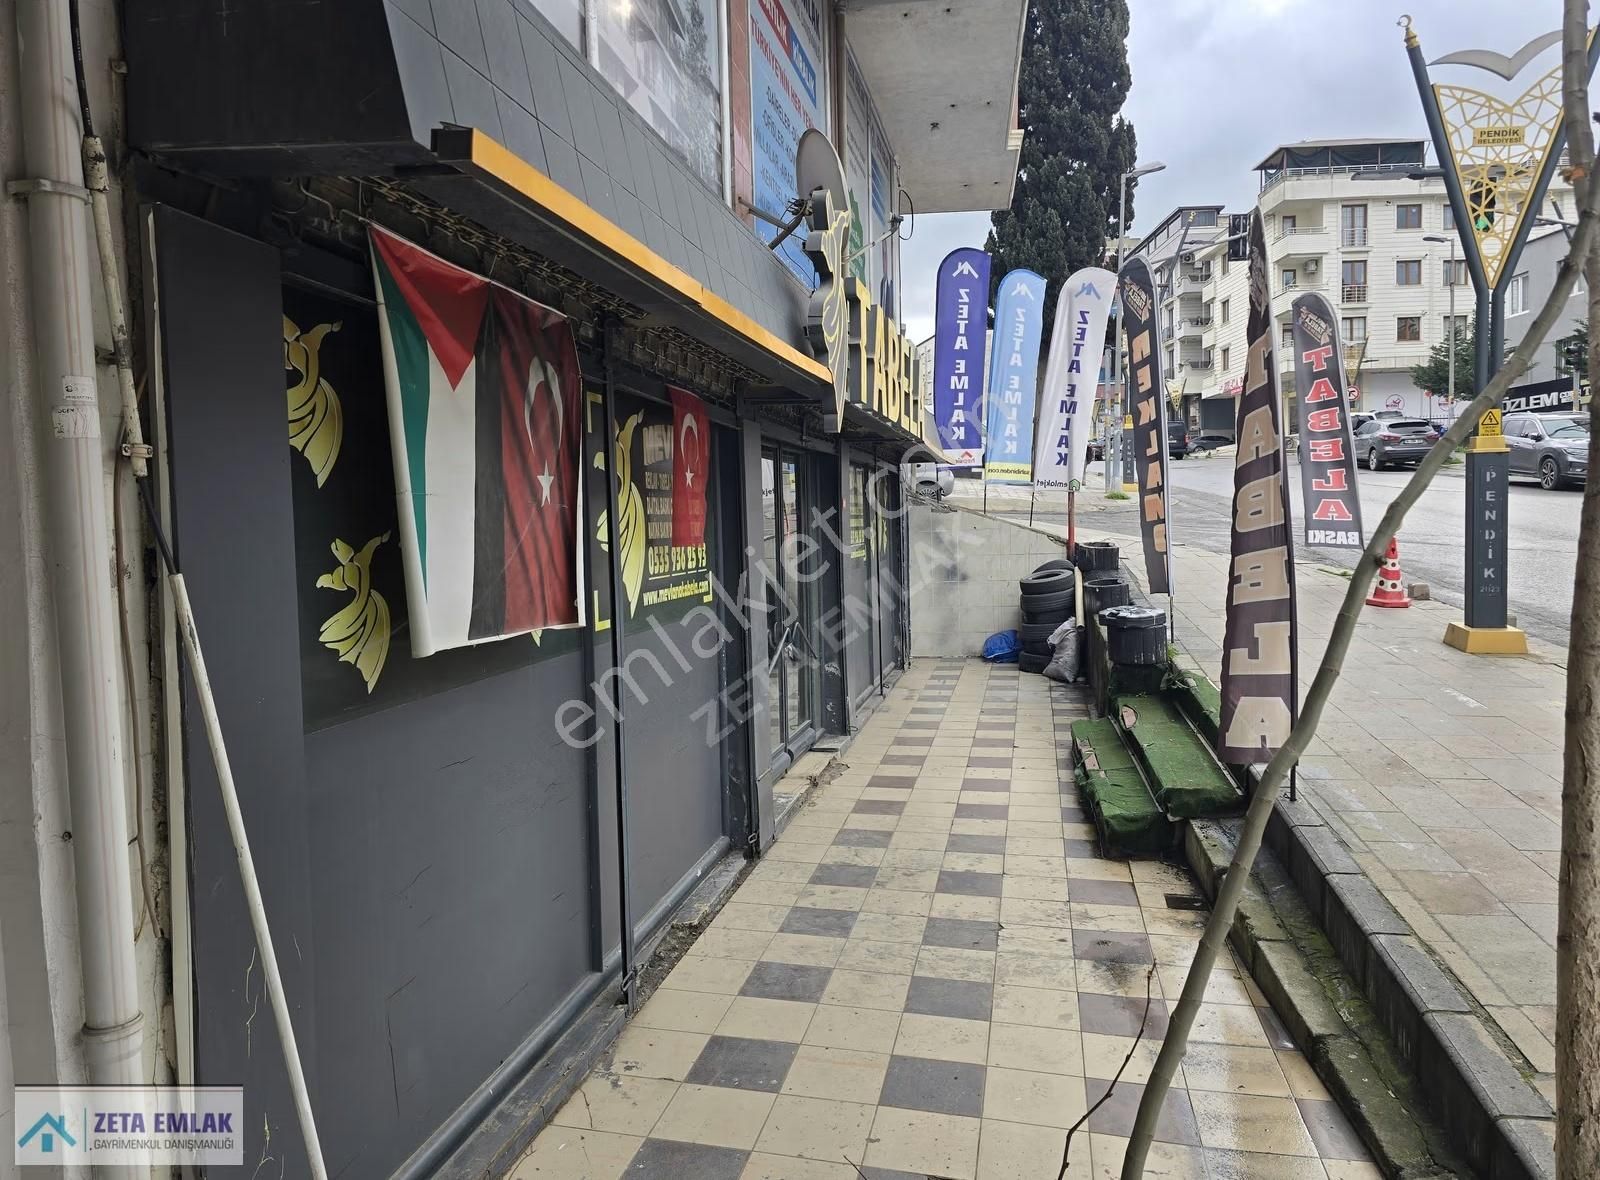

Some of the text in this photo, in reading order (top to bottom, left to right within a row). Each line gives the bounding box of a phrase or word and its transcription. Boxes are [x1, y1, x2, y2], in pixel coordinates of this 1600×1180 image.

[1477, 137, 1522, 145] BELEDİYESİ
[1480, 128, 1520, 138] PENDİK
[855, 278, 925, 444] TABELA
[1502, 392, 1559, 413] ÖZLEM
[1483, 471, 1497, 579] PENDİK
[648, 542, 707, 576] 0535 936 25 93
